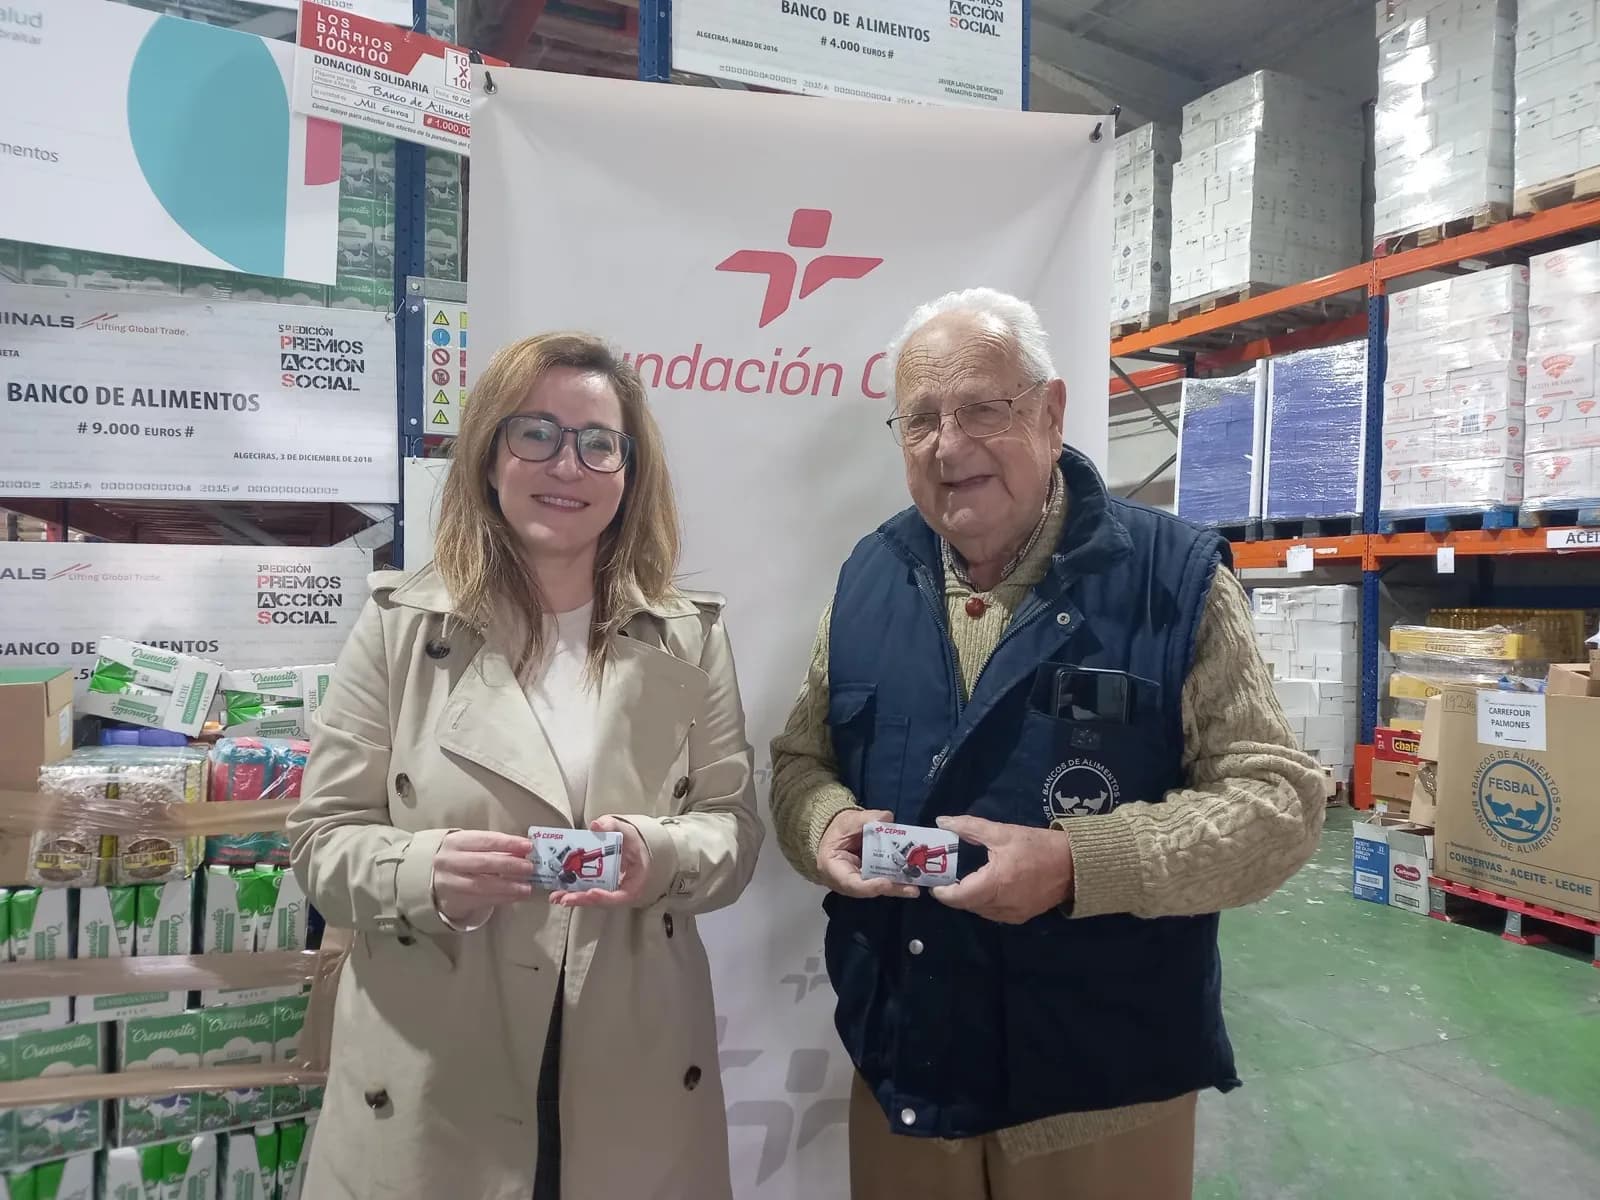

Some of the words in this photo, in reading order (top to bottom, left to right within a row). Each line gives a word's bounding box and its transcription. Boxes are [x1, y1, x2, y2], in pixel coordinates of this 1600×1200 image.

[316, 10, 350, 29] LOS
[781, 0, 827, 22] BANCO
[834, 13, 850, 27] DE
[856, 15, 931, 43] ALIMENTOS
[949, 2, 1004, 24] ACCIÓN
[316, 22, 393, 52] BARRIOS
[949, 16, 1001, 38] SOCIAL
[731, 37, 753, 49] MARZO
[754, 42, 762, 51] DE
[829, 38, 860, 53] 4.000
[862, 47, 887, 59] EUROS
[453, 54, 472, 68] 10
[313, 54, 371, 78] DONACIÓN
[373, 70, 429, 95] SOLIDARIA
[453, 77, 472, 91] 10
[368, 85, 407, 103] Banco
[410, 96, 423, 108] de
[425, 101, 471, 121] Aliment
[96, 322, 127, 334] Lifting
[128, 323, 158, 335] Global
[292, 325, 334, 337] EDICIÓN
[280, 335, 364, 355] PREMIOS
[280, 353, 365, 374] ACCIÓN
[281, 373, 361, 391] SOCIAL
[7, 382, 89, 405] BANCO
[95, 386, 126, 407] DE
[130, 387, 261, 413] ALIMENTOS
[92, 421, 140, 436] 9.000
[144, 427, 182, 438] EUROS
[286, 453, 297, 461] DE
[299, 454, 341, 463] DICIEMBRE
[342, 455, 352, 463] DE
[269, 562, 312, 574] EDICIÓN
[257, 575, 342, 589] PREMIOS
[257, 589, 343, 609] ACCIÓN
[257, 610, 338, 625] SOCIAL
[71, 641, 96, 655] DE
[1488, 706, 1531, 718] CARREFOUR
[1490, 718, 1531, 729] PALMONES
[1041, 762, 1067, 796] BANCOS
[1067, 757, 1081, 767] DE
[1081, 758, 1121, 798] ALIMENTOS
[1471, 753, 1496, 789] BANCOS
[1497, 750, 1510, 760] DE
[1513, 751, 1561, 803] ALIMENTOS
[1487, 776, 1540, 797] FESBAL
[1500, 841, 1513, 852] DE
[1516, 815, 1562, 854] ALIMENTOS
[1449, 851, 1503, 873] CONSERVAS
[1510, 867, 1547, 885] ACEITE
[1555, 879, 1593, 896] LECHE
